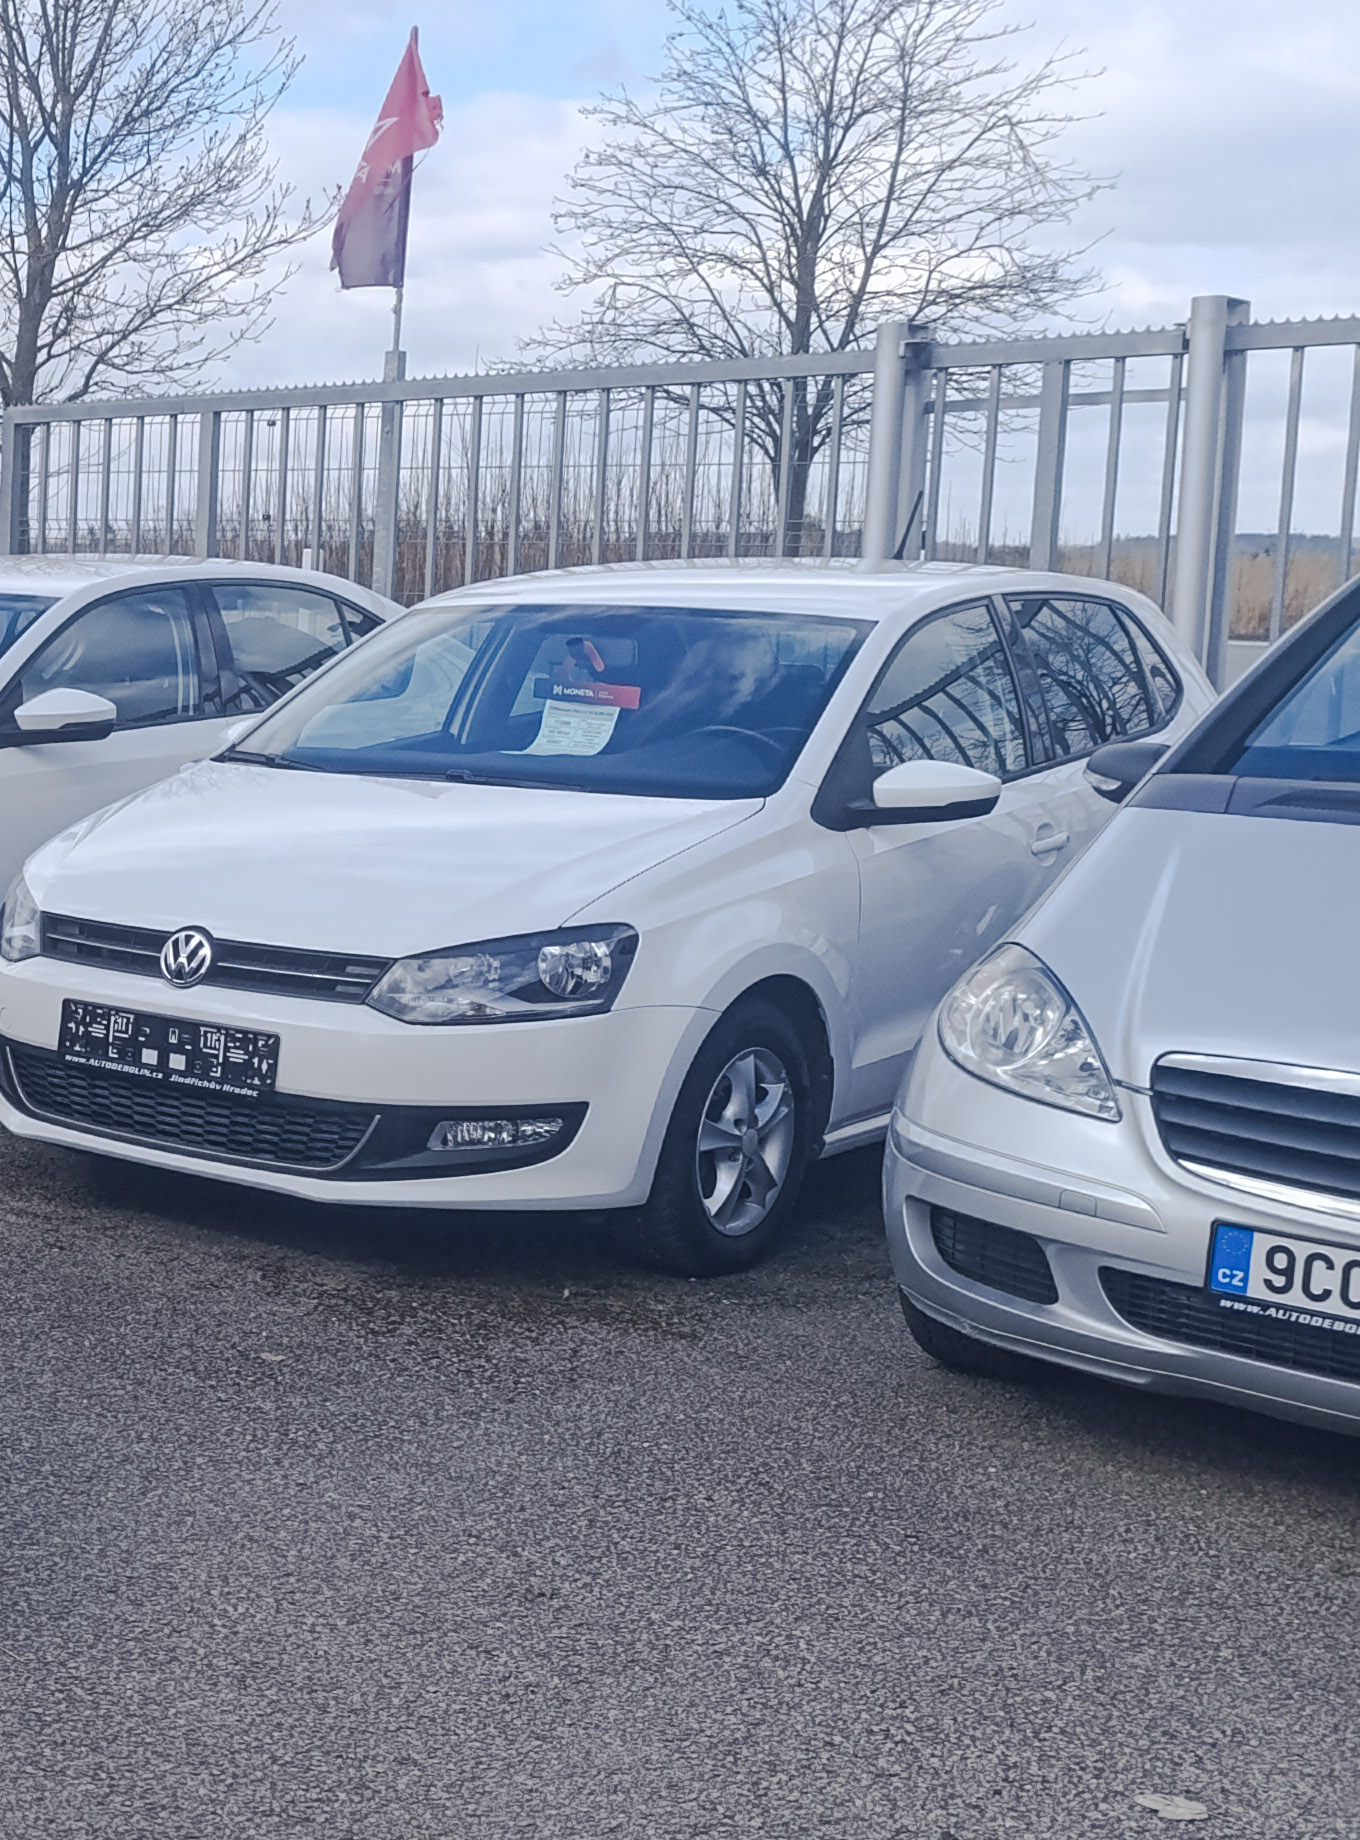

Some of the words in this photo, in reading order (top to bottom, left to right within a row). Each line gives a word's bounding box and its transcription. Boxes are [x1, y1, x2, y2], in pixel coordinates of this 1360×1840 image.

[64, 1054, 164, 1079] www.AUTODEBOLIN.cz
[222, 1083, 259, 1098] Hradec
[1217, 1268, 1244, 1287] CZ
